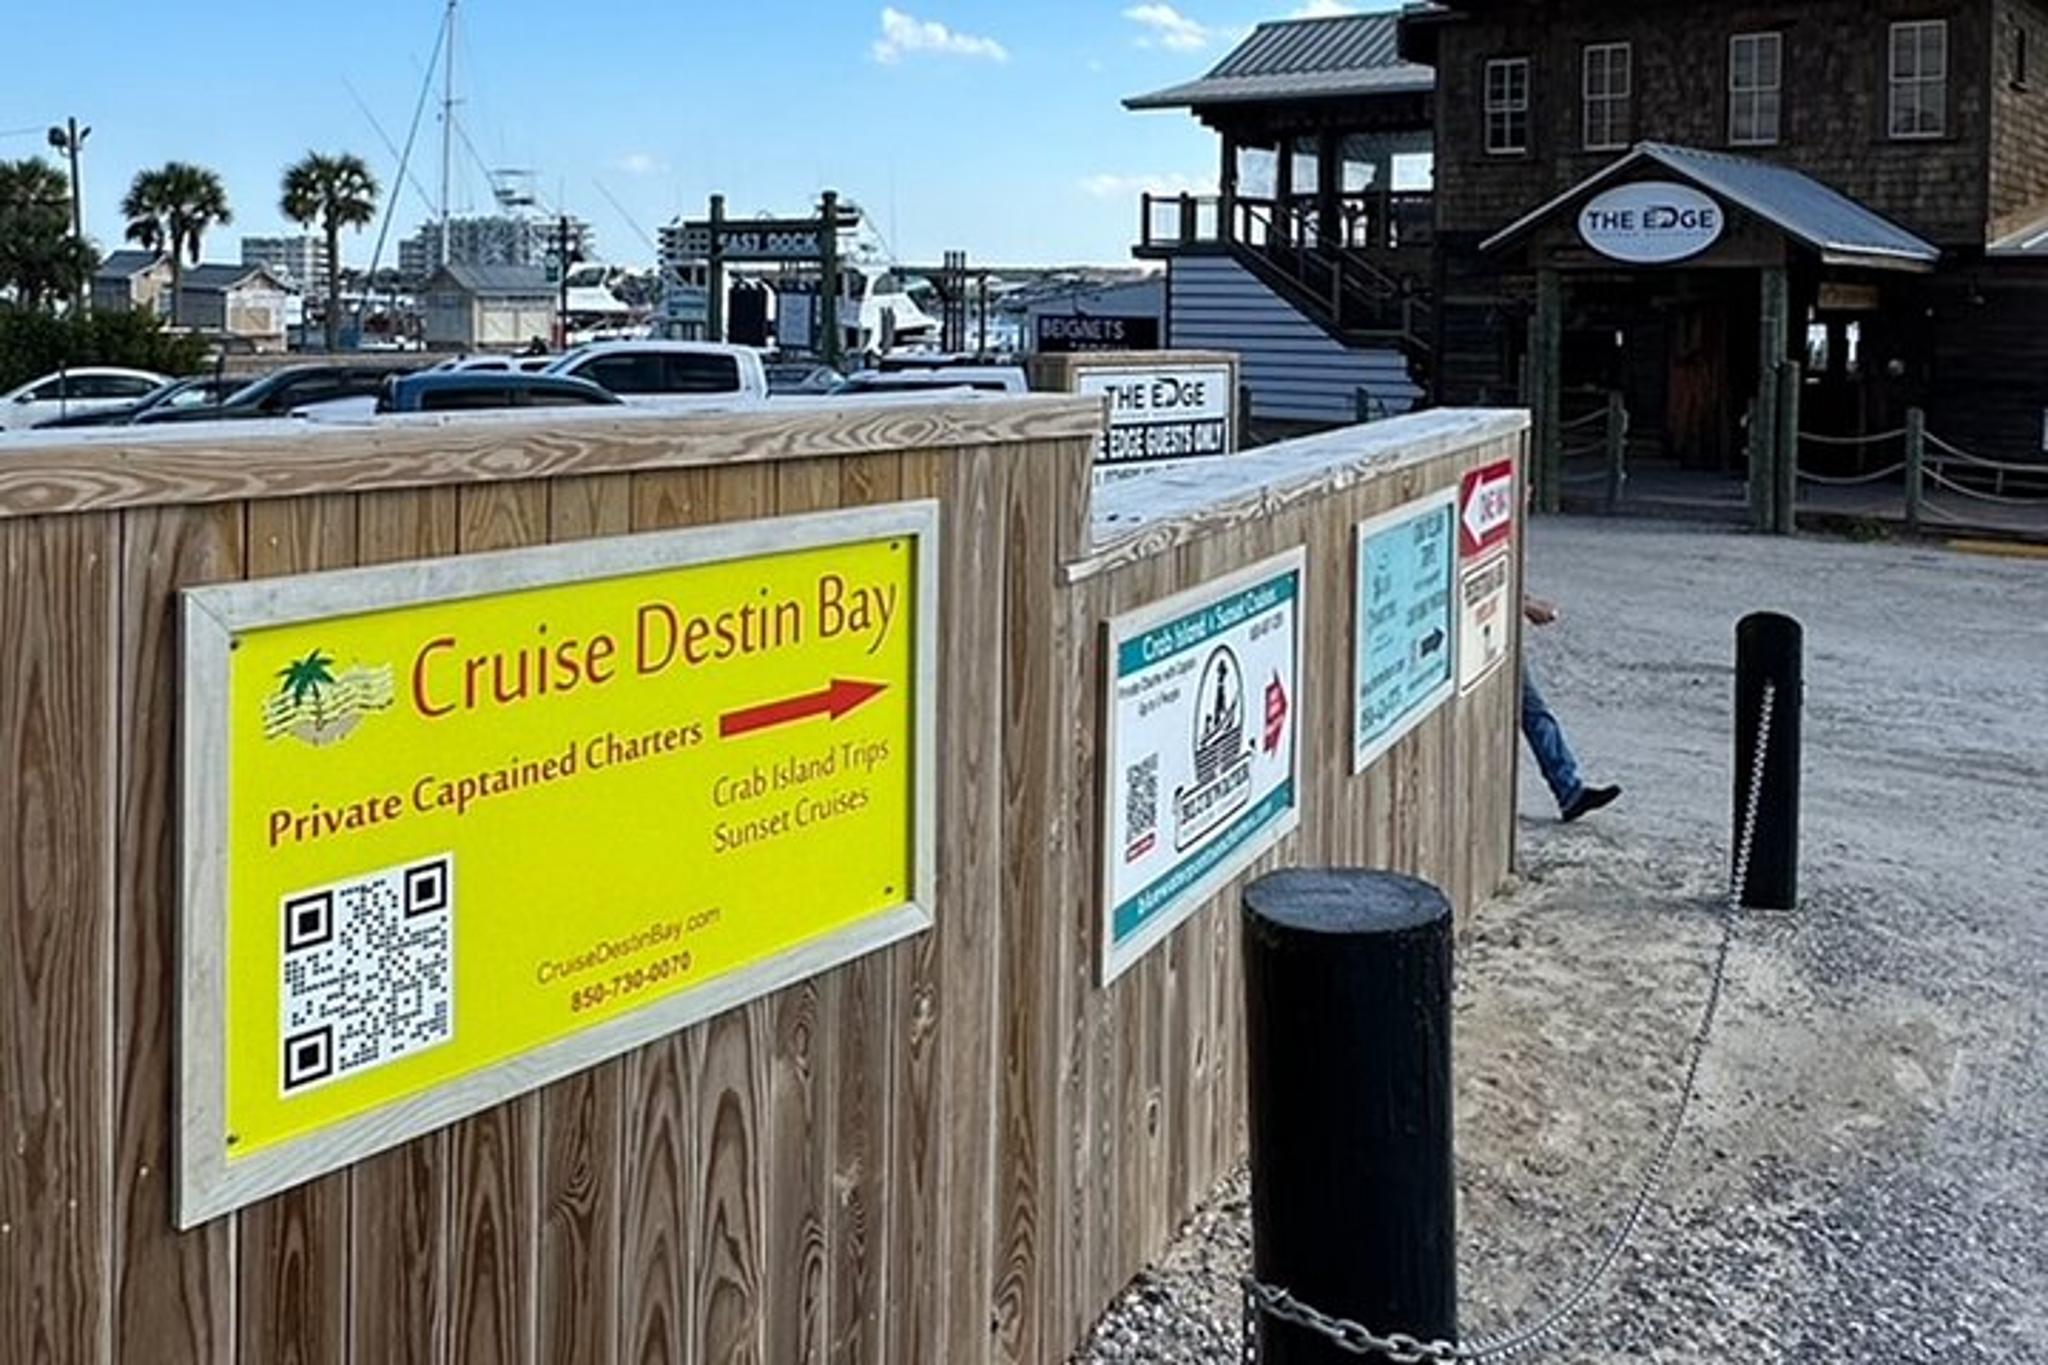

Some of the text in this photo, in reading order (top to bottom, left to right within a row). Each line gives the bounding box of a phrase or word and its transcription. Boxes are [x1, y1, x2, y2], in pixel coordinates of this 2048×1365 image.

[718, 232, 817, 251] EAST DOCK
[1588, 205, 1713, 230] THE EDGE
[1041, 318, 1125, 340] BEIGNETS
[1104, 378, 1206, 410] THE EDGE
[1111, 428, 1145, 460] EDGE
[1147, 425, 1194, 457] GUESTS
[411, 574, 897, 719] Cruise Destin Bay
[269, 723, 703, 846] Private Captained Charters
[713, 737, 889, 808] Crab Island Trips
[712, 786, 870, 853] Sunset Cruises
[537, 906, 721, 984] CruiseDestinBay.com
[571, 951, 692, 1013] 850-730-0070
